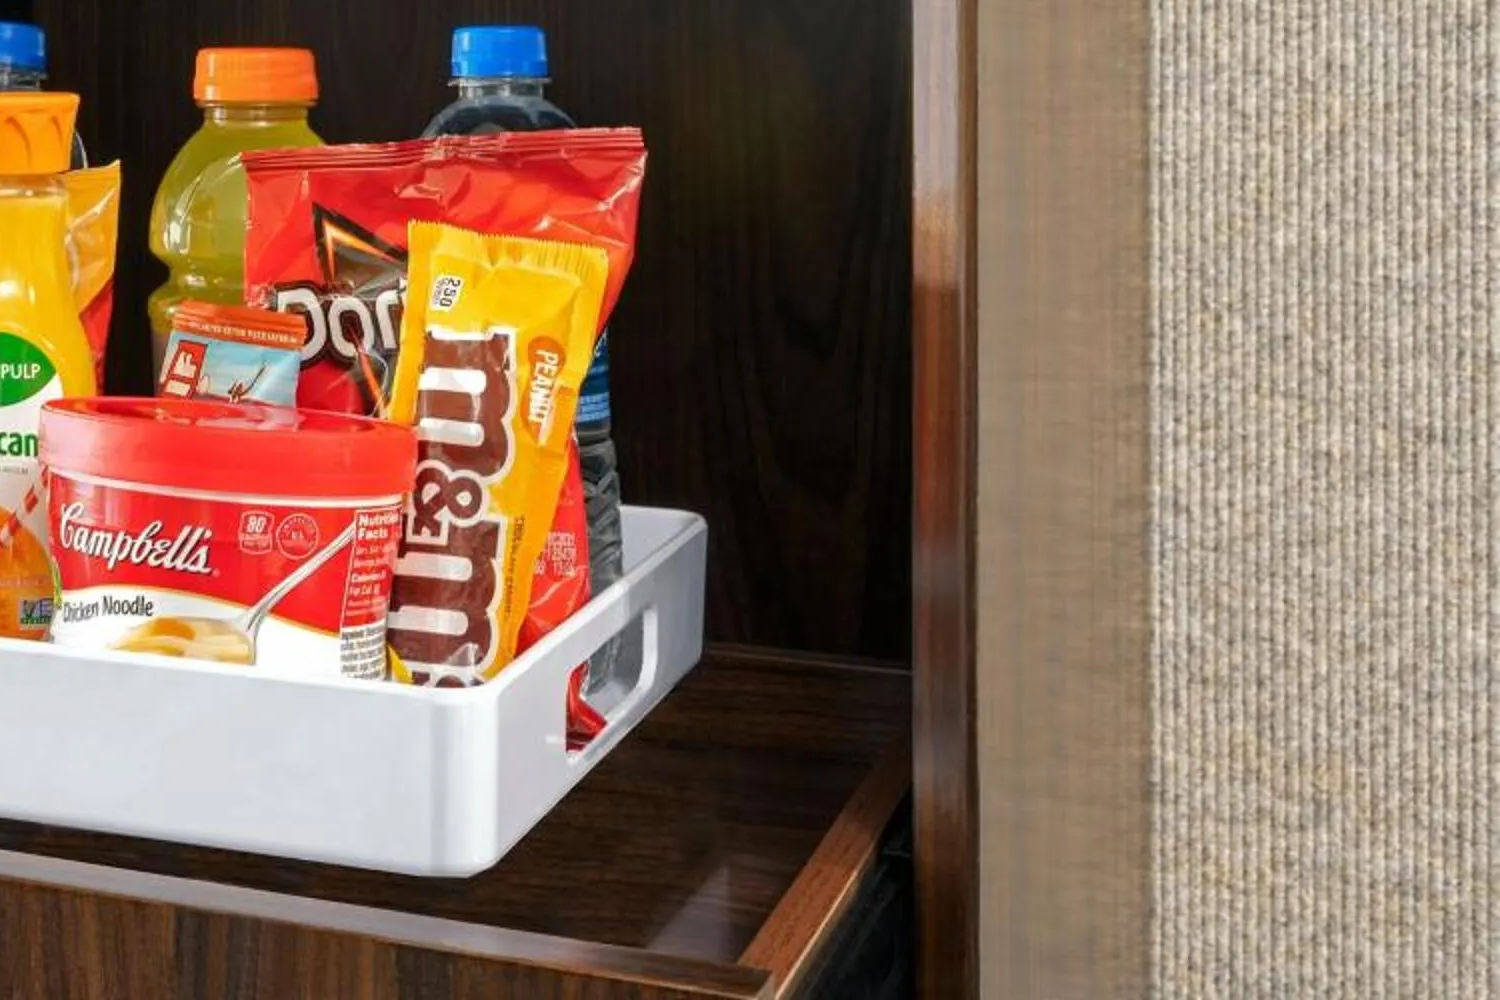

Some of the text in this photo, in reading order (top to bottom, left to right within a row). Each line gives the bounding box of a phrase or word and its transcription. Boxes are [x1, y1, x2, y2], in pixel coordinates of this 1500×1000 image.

[439, 278, 460, 307] 250
[276, 286, 403, 362] Dor
[1, 363, 41, 379] PULP
[528, 350, 559, 424] PEANUT
[60, 502, 213, 575] Campbell's
[246, 516, 266, 534] 80
[357, 527, 389, 540] Facts
[63, 600, 99, 623] Chicken
[102, 595, 154, 618] Noodle
